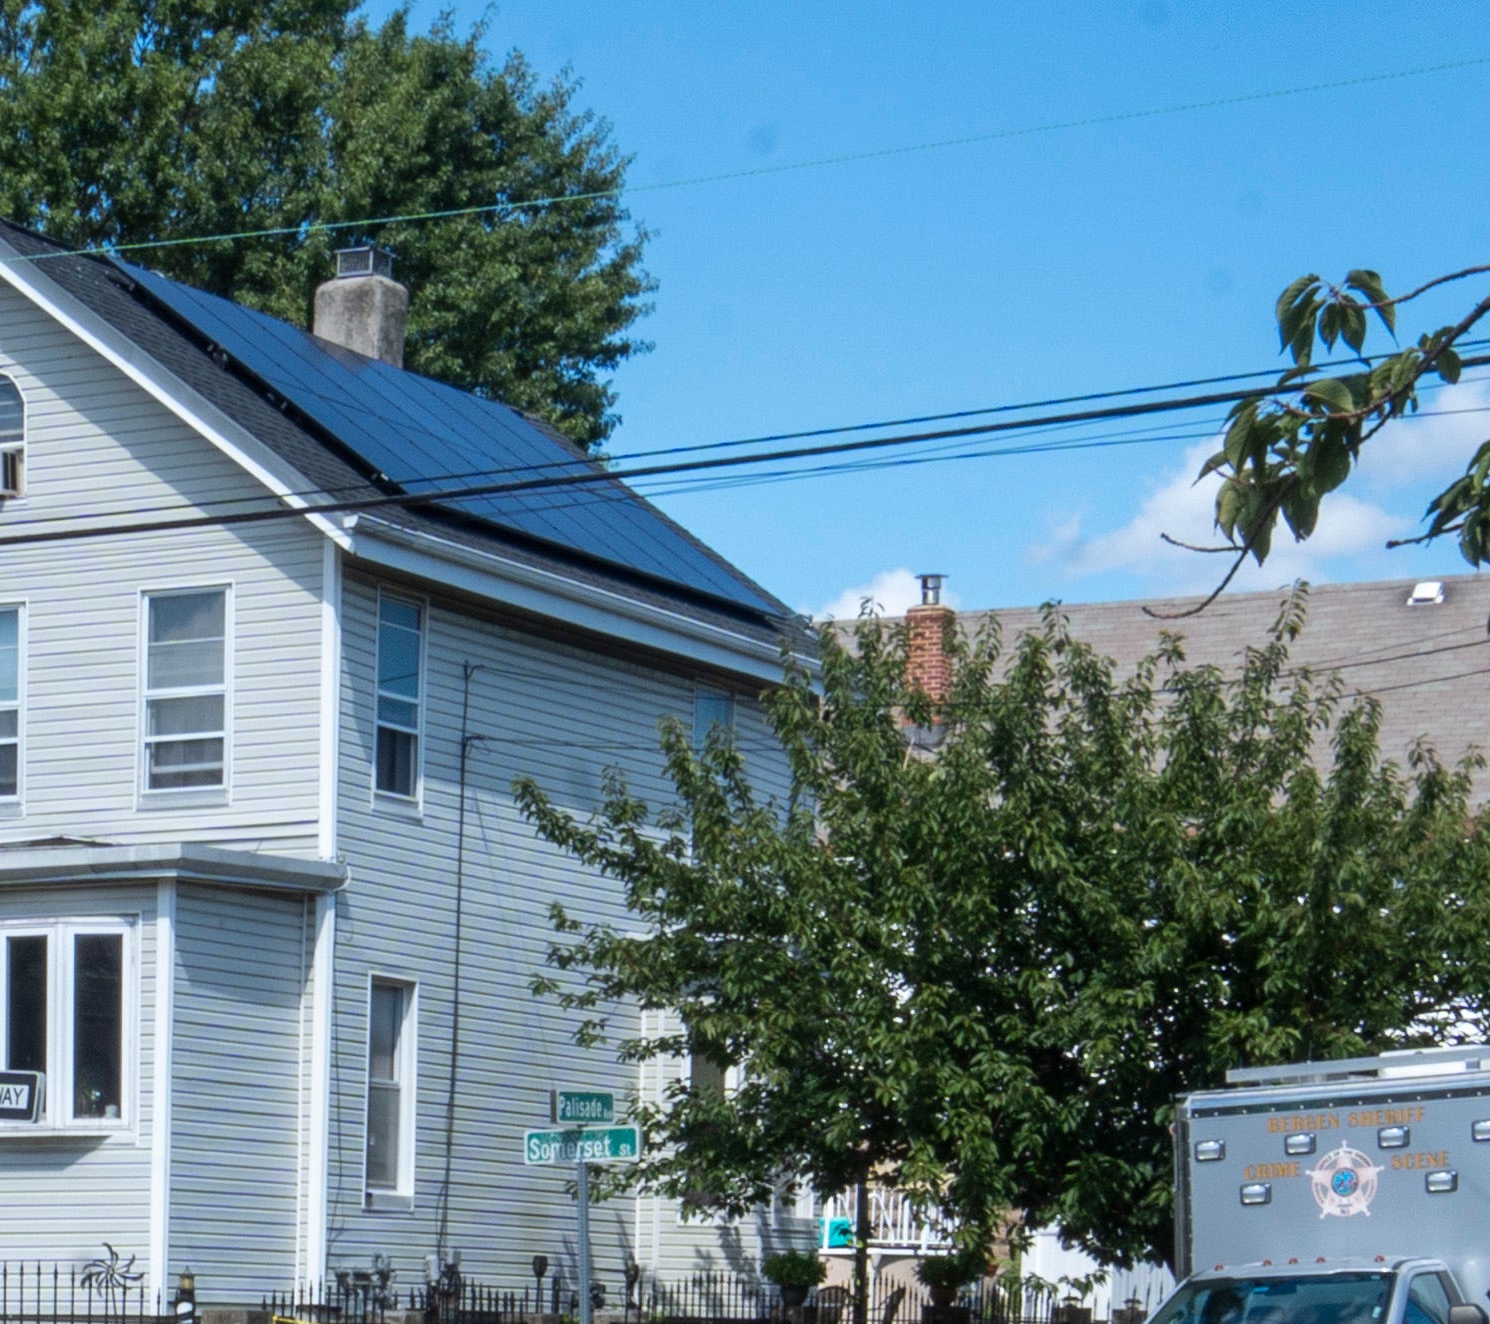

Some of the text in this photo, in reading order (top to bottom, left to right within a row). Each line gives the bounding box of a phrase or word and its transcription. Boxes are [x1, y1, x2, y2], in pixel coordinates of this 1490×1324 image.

[559, 1096, 602, 1117] Palisade
[1266, 1107, 1425, 1133] BERGEN SHERIFF
[529, 1134, 612, 1160] Somerset
[1243, 1162, 1300, 1180] CRIME
[1390, 1151, 1451, 1171] SCENE
